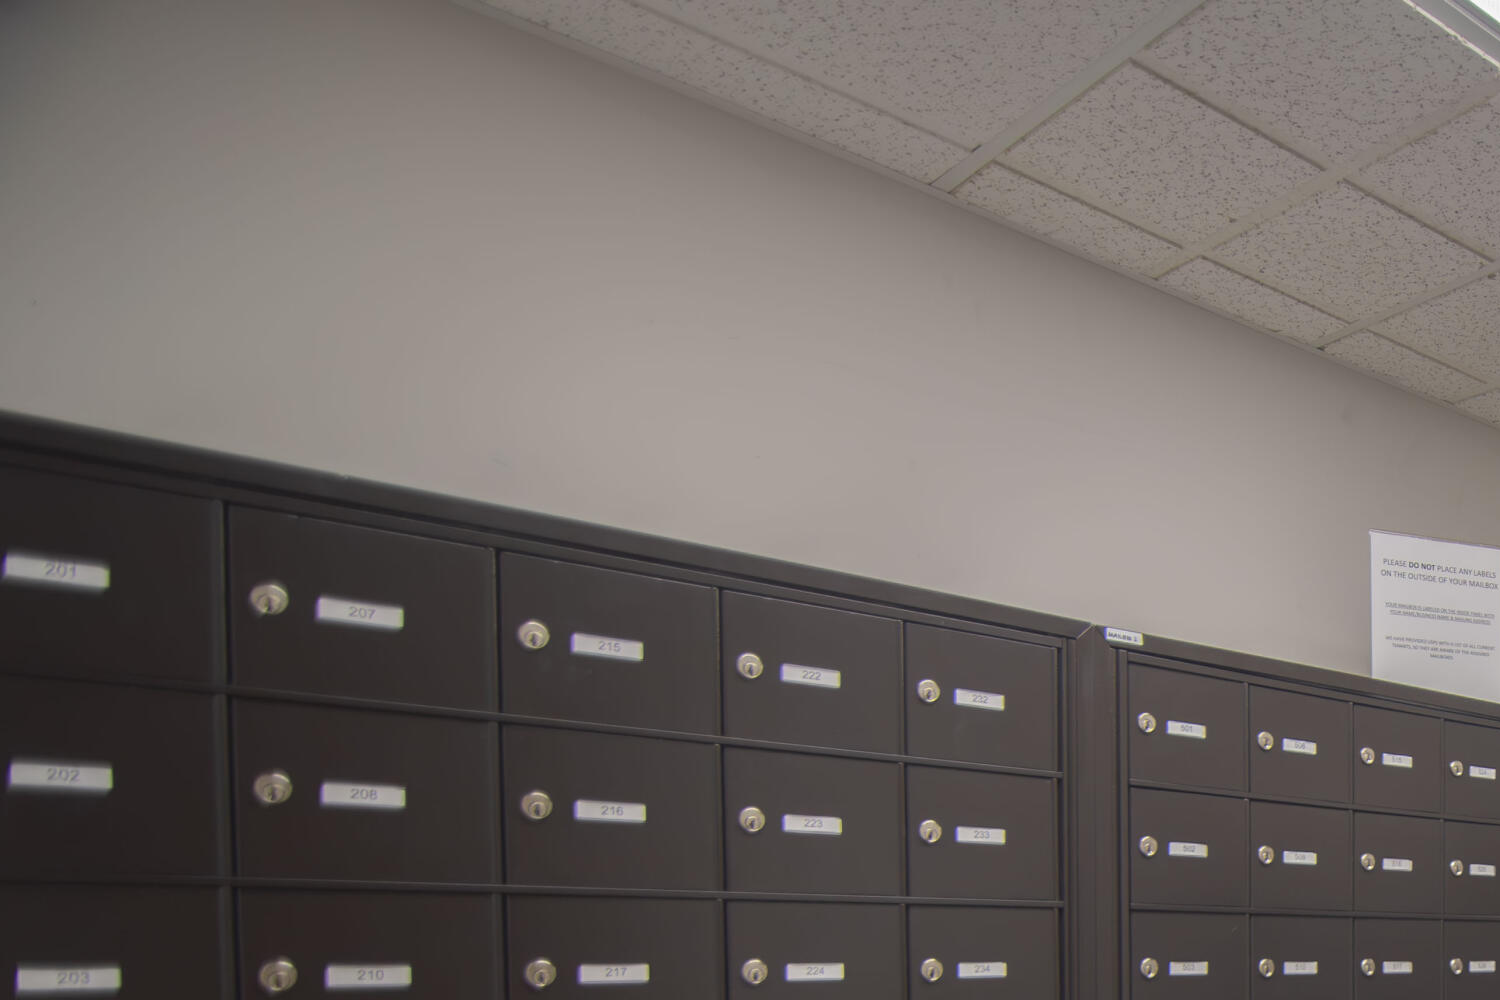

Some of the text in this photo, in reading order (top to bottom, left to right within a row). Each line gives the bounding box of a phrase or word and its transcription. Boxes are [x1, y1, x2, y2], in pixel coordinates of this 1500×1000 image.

[46, 560, 76, 579] 201
[1383, 558, 1497, 579] PLEASE DO NOT PLACE ANY LABELS
[1394, 570, 1406, 579] THE
[1408, 572, 1437, 583] OUTSIDE
[1439, 576, 1448, 584] OF
[1450, 578, 1467, 587] YOUR
[1469, 580, 1499, 590] MAILBOX
[349, 606, 375, 620] 207
[598, 640, 620, 652] 215
[802, 669, 821, 681] 222
[972, 694, 988, 704] 232
[1181, 724, 1193, 733] 501
[47, 768, 79, 782] 202
[350, 787, 377, 800] 208
[600, 804, 623, 816] 216
[804, 818, 823, 828] 223
[974, 830, 990, 839] 233
[357, 969, 384, 980] 210
[605, 966, 627, 976] 217
[806, 966, 825, 975] 224
[975, 964, 991, 973] 234
[58, 969, 90, 984] 203
